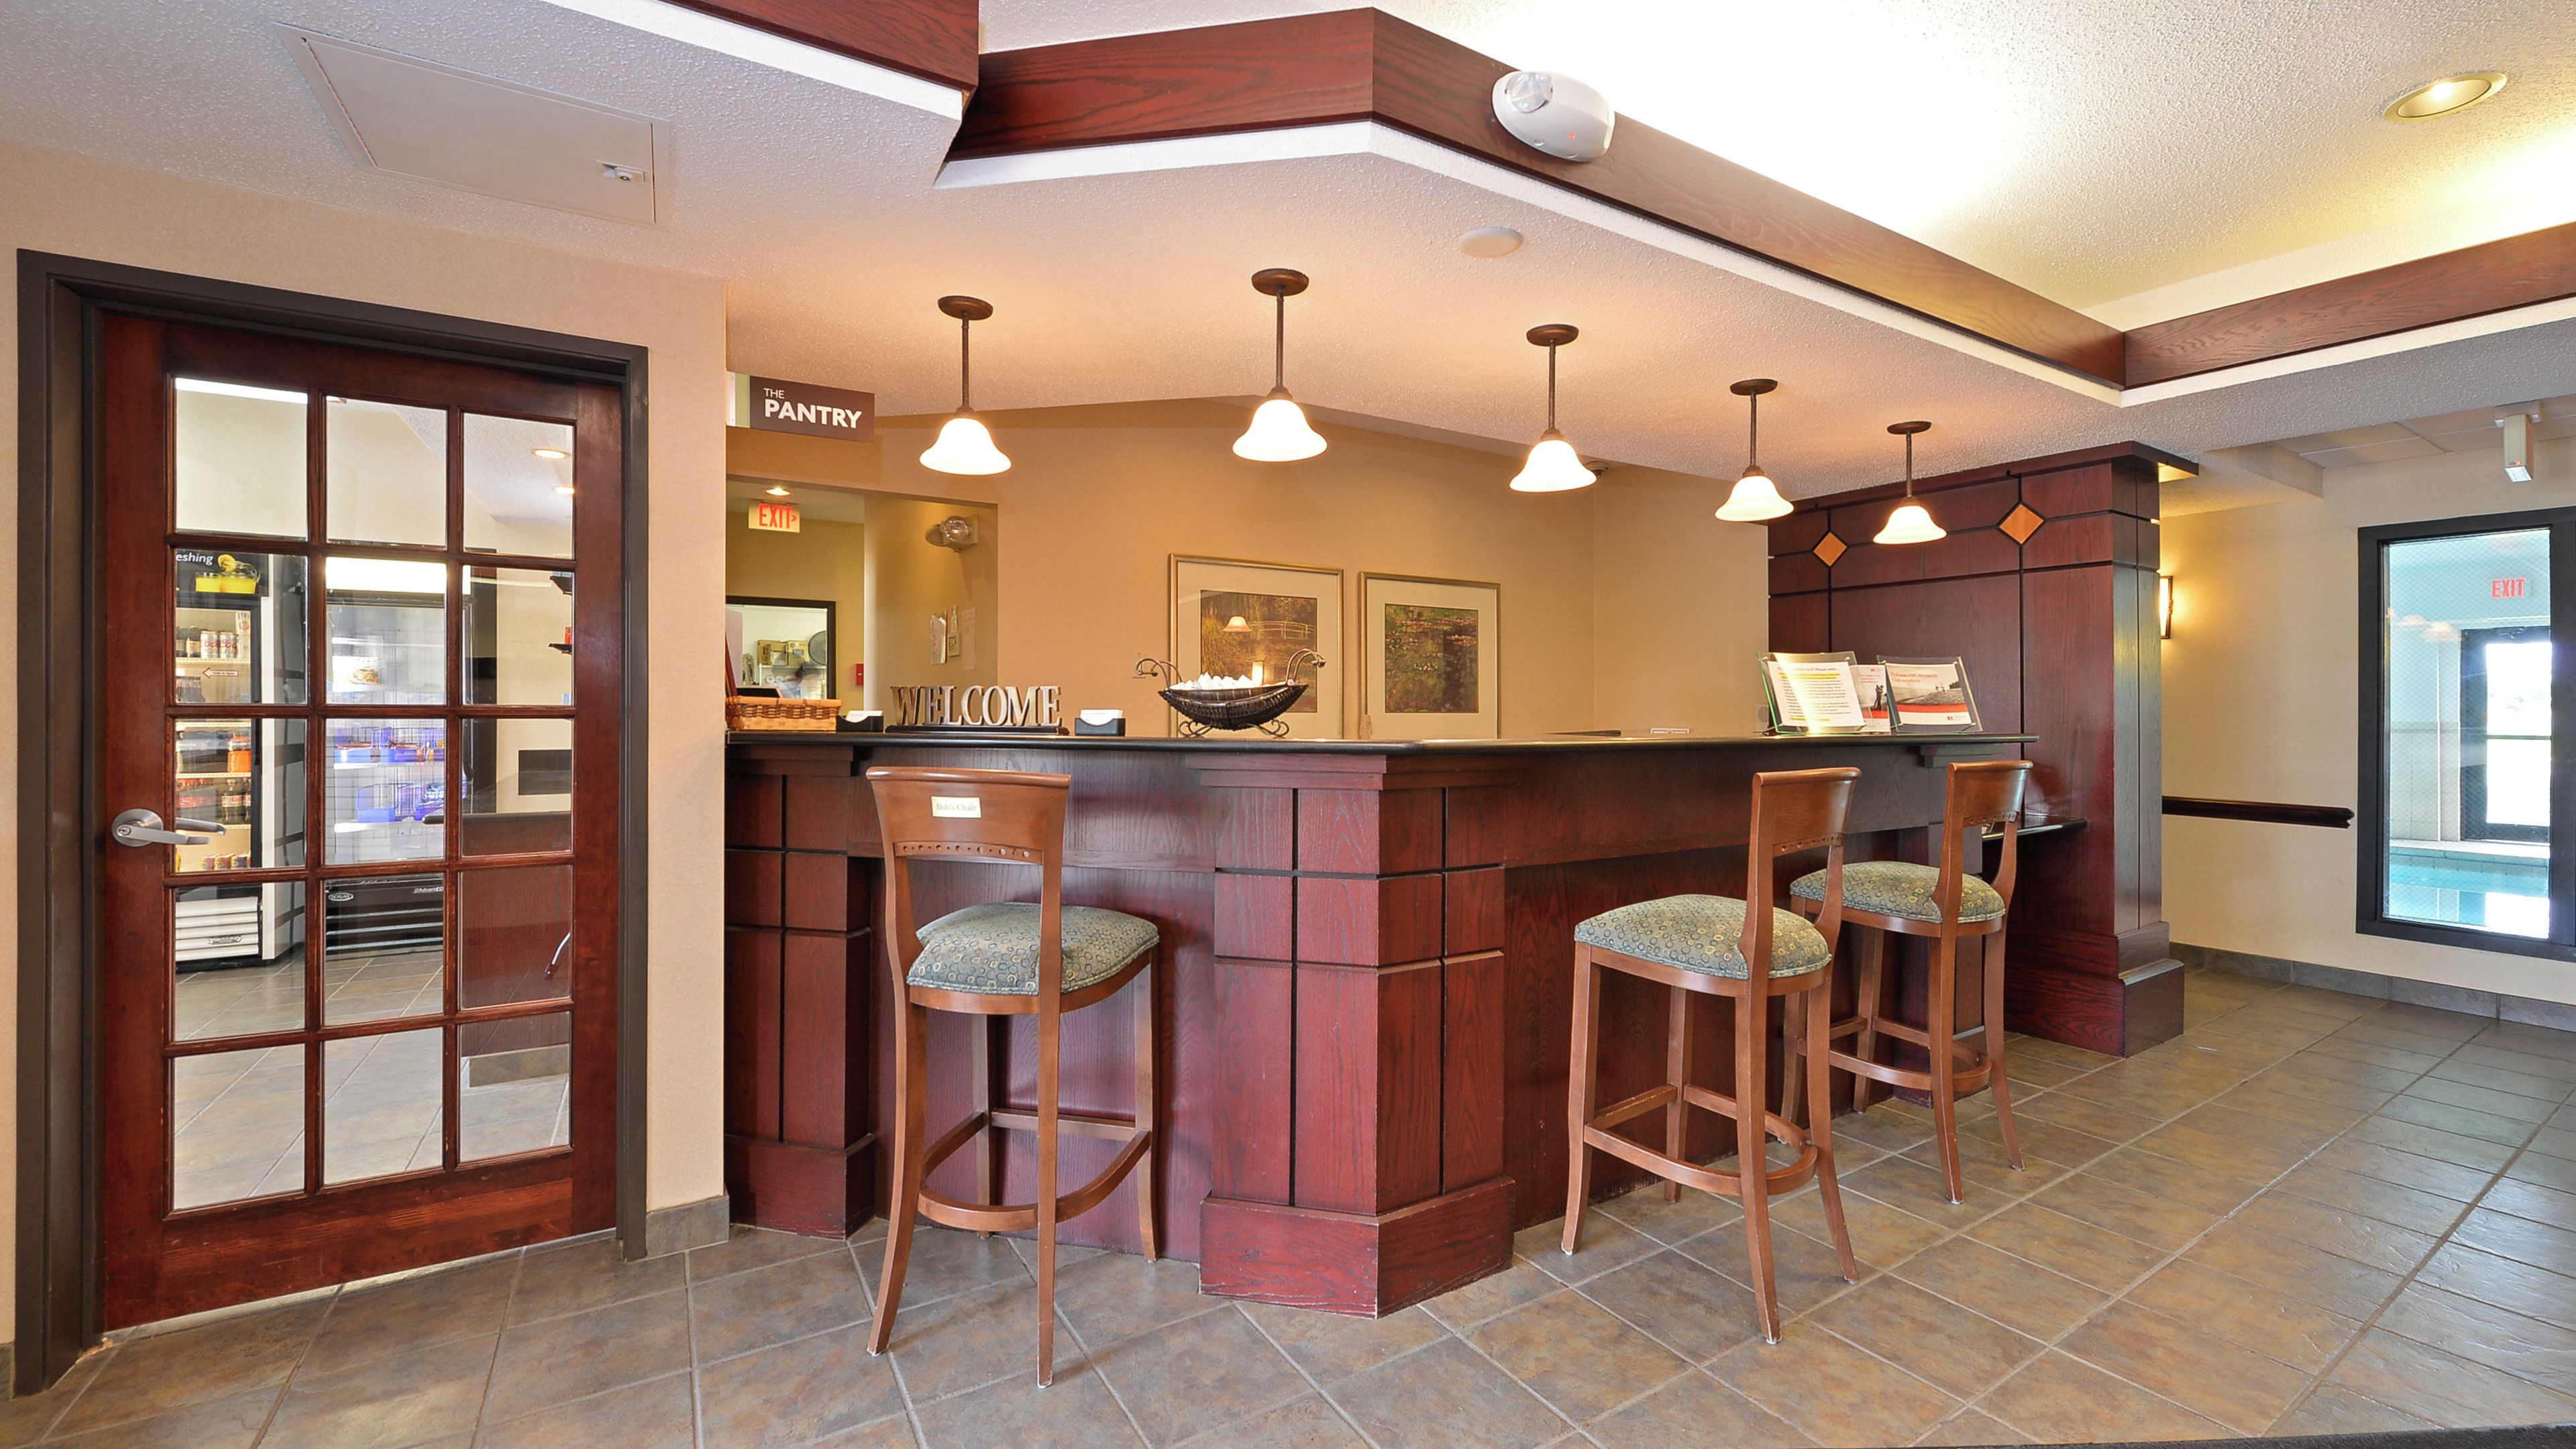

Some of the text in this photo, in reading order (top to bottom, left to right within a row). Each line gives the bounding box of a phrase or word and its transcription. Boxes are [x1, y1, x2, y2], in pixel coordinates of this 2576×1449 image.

[763, 387, 785, 400] THE
[765, 398, 863, 429] PANTRY
[759, 503, 794, 529] EXIT
[2491, 578, 2525, 598] EXIT
[890, 684, 1062, 728] WELCOME
[956, 804, 977, 812] Chair
